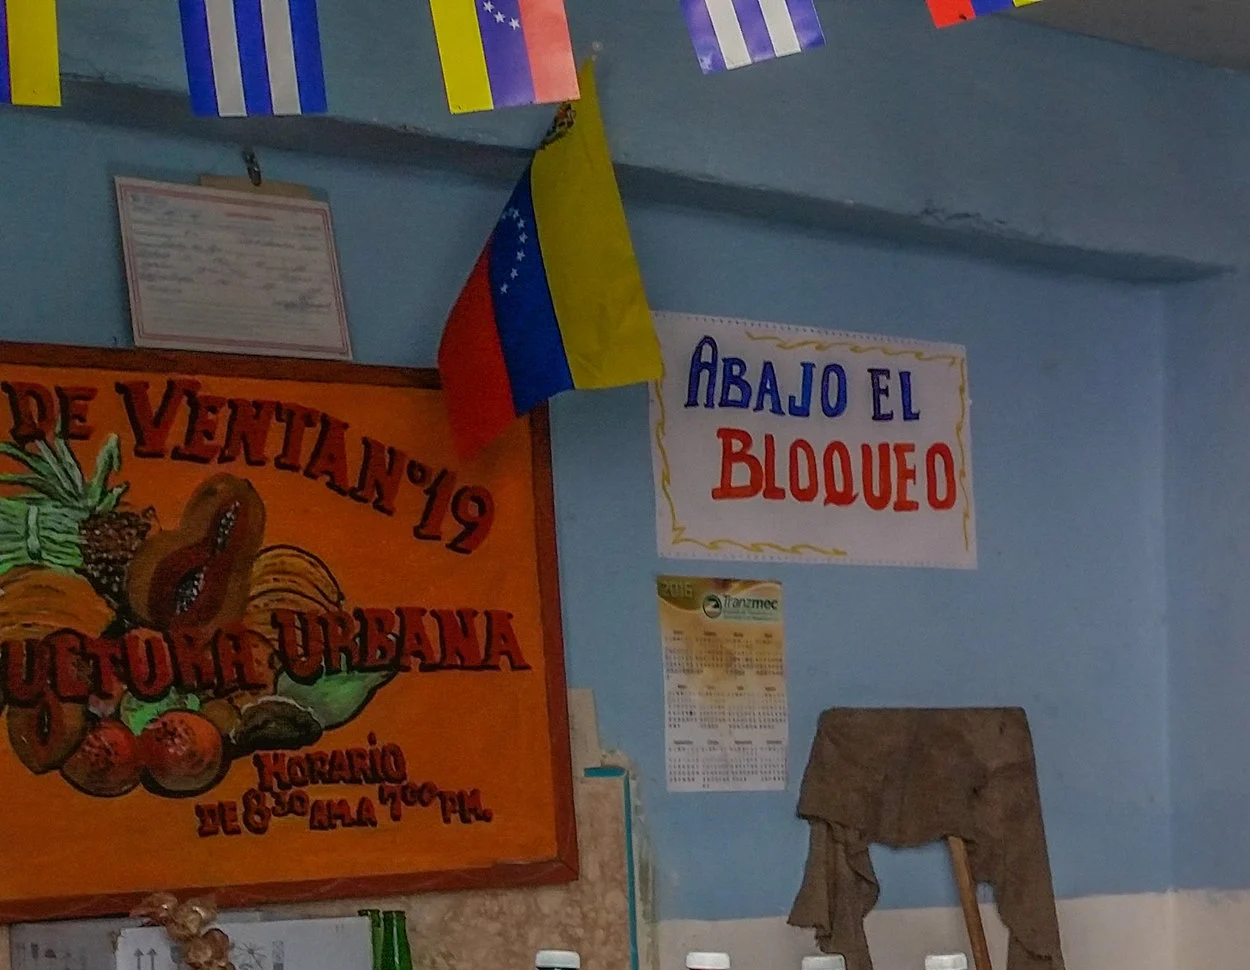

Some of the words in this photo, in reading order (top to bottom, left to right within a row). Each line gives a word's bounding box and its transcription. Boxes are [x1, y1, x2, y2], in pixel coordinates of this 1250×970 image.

[1, 380, 98, 446] DE
[684, 336, 848, 418] ABAJO
[868, 367, 921, 421] EL
[711, 427, 958, 512] BLOQUEO
[270, 606, 530, 685] URBANA
[195, 801, 241, 837] DE
